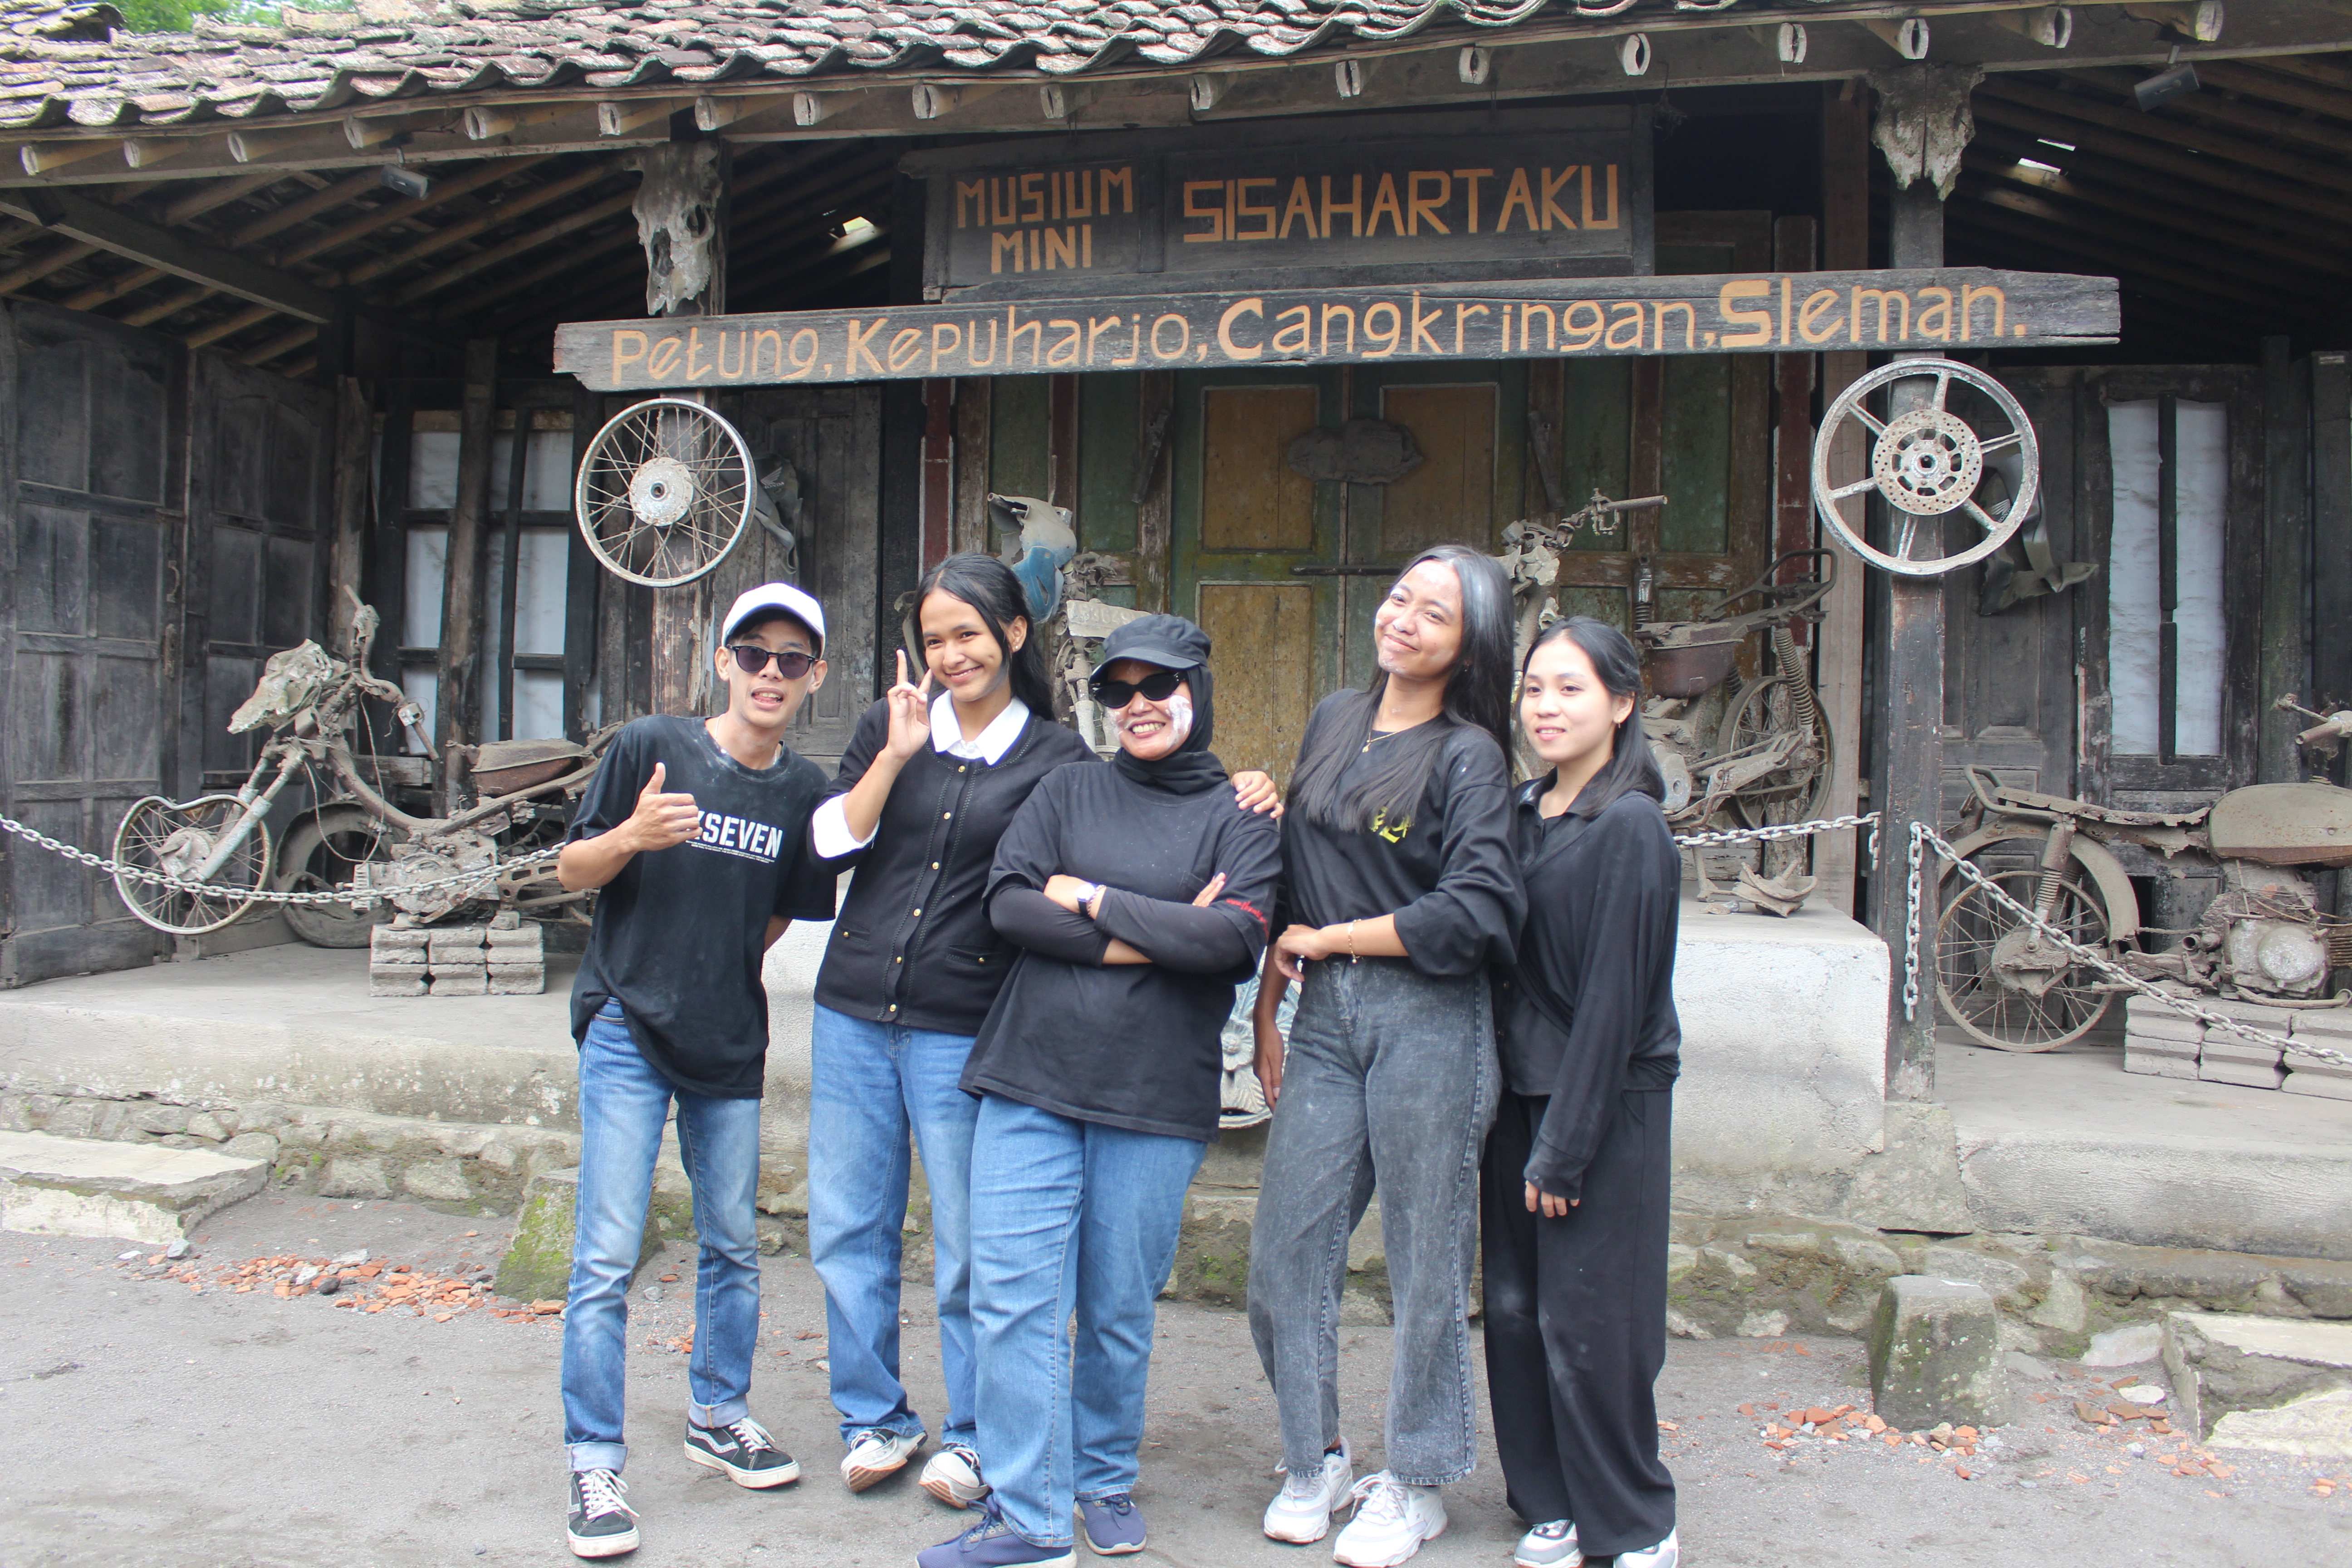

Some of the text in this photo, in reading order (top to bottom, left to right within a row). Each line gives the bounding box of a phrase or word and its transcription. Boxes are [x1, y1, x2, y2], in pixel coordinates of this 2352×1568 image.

[957, 167, 1133, 228] MUSIUM
[1183, 164, 1619, 243] SISAHARTAKU
[991, 224, 1092, 274] MINI
